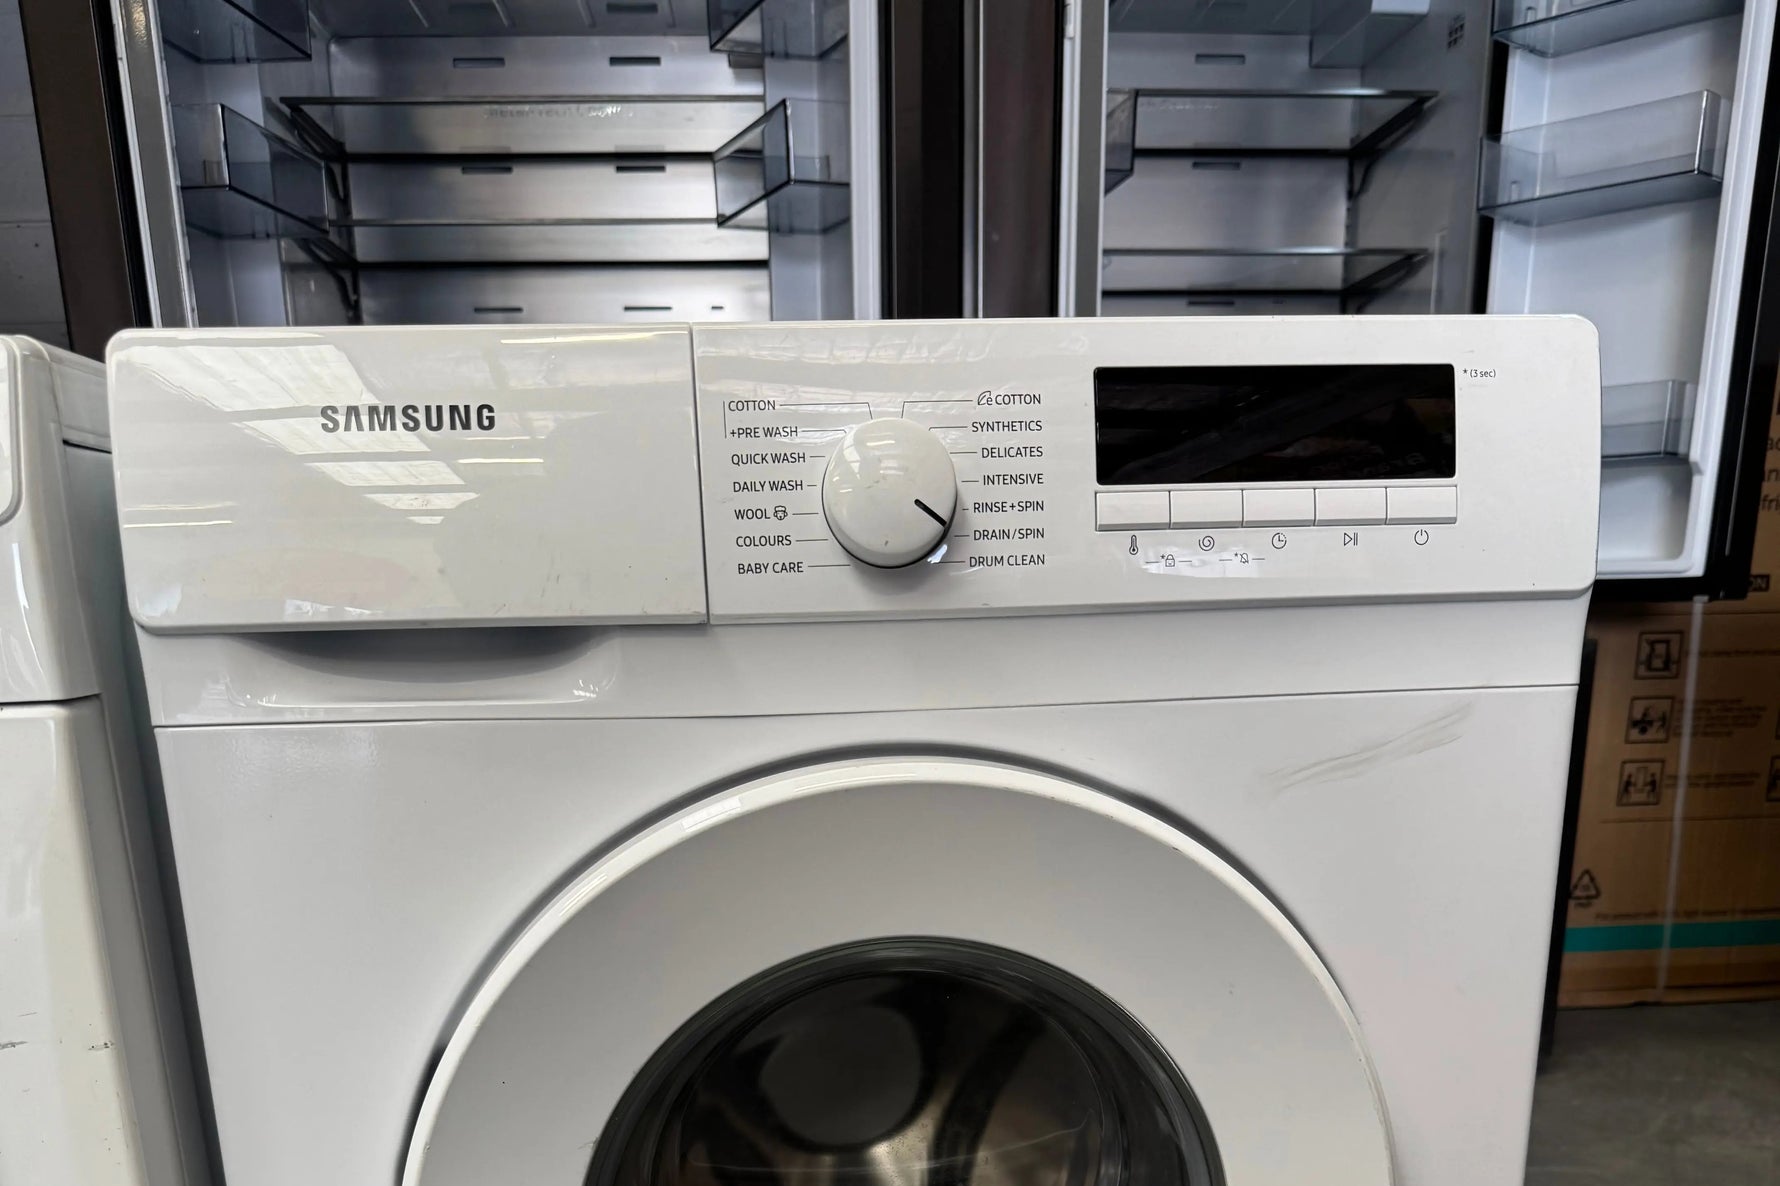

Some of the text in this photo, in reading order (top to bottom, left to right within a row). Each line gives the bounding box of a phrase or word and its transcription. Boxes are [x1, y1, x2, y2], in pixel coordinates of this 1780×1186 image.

[1479, 368, 1496, 378] sec)
[728, 400, 776, 412] COTTON
[994, 394, 1041, 406] COTTON
[320, 404, 496, 433] SAMSUNG
[730, 426, 798, 438] +PRE WASH
[971, 420, 1043, 433] SYNTHETICS
[982, 446, 1044, 458] DELICATES
[731, 452, 806, 466] QUICK WASH
[983, 473, 1044, 486] INTENSIVE
[733, 480, 804, 492] DAILY WASH
[734, 508, 771, 520] WOOL
[736, 534, 792, 548] COLOURS
[969, 554, 1045, 568] DRUM CLEAN
[738, 562, 804, 574] BABY CARE
